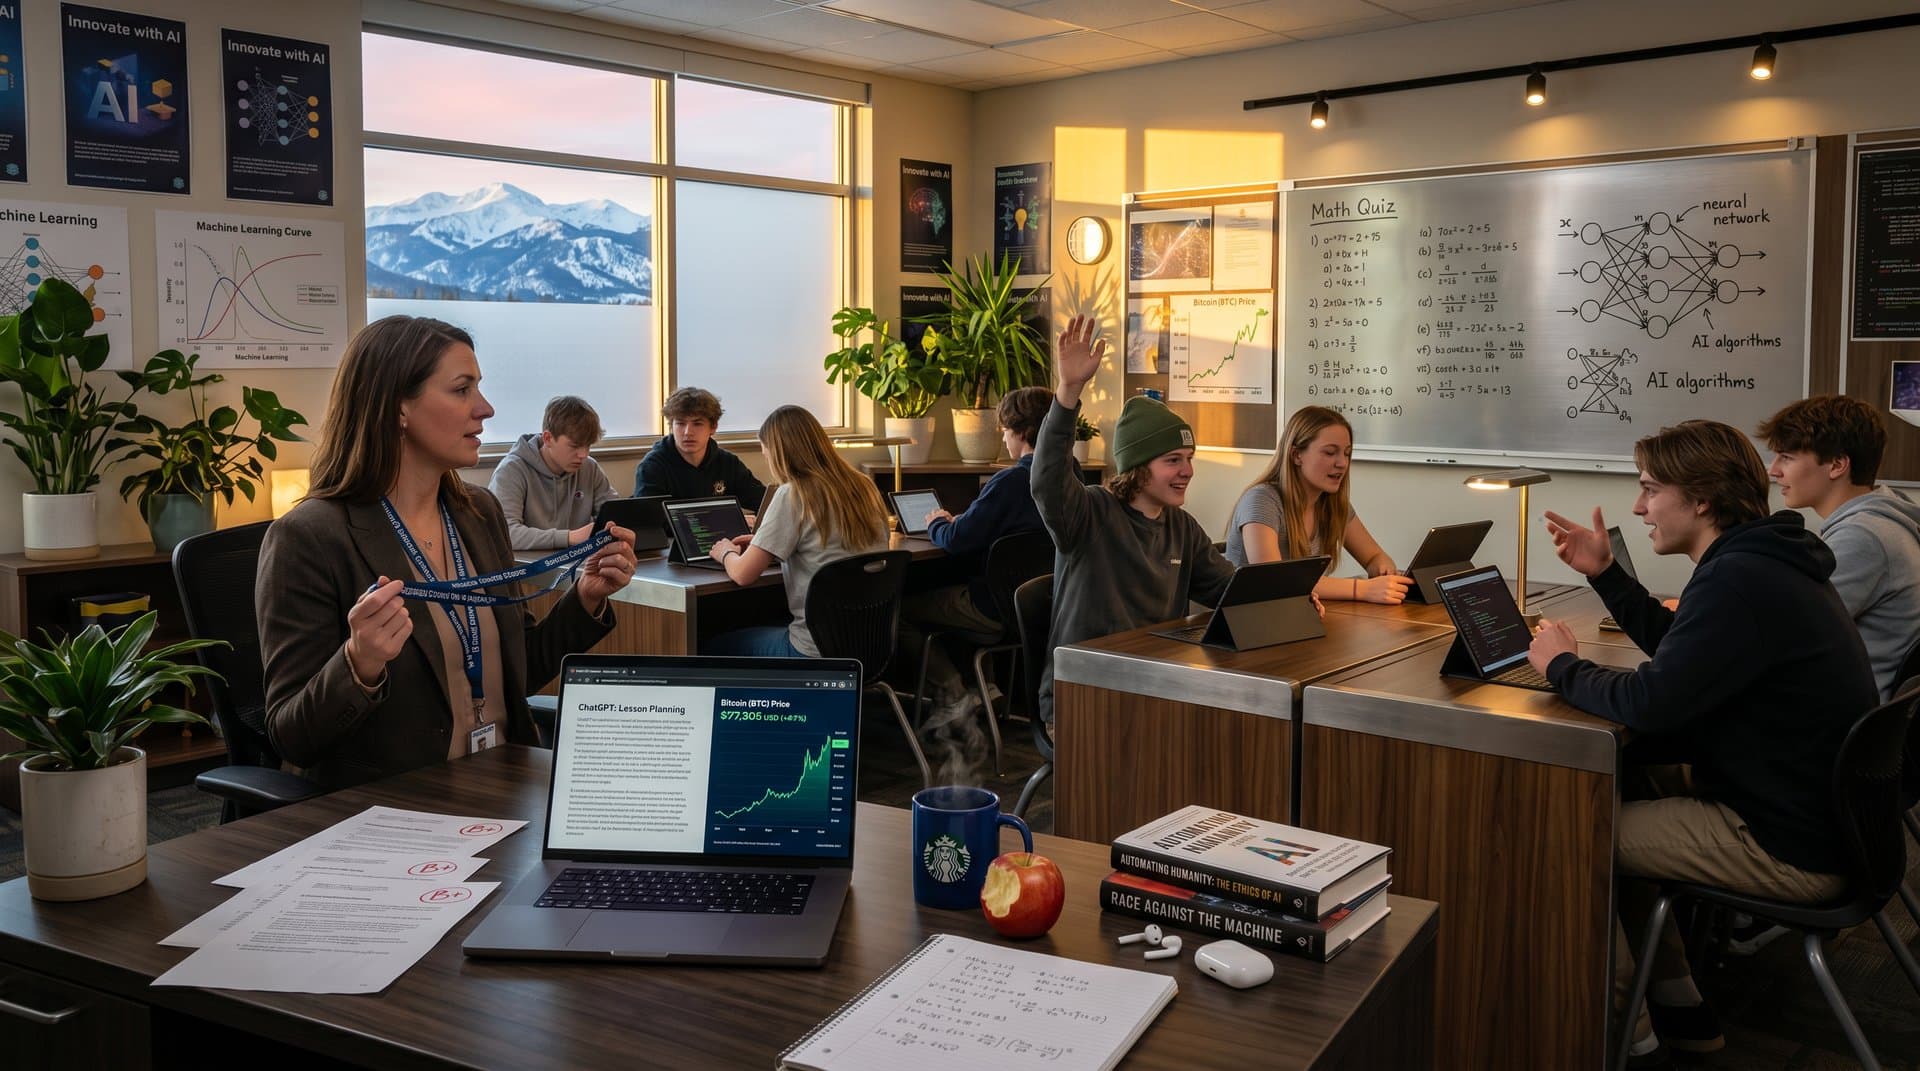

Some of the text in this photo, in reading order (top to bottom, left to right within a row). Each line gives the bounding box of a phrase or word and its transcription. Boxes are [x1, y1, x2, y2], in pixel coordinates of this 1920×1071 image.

[0, 5, 15, 19] AI
[68, 14, 182, 44] Innovate with AI
[228, 39, 326, 65] Innovate with AI
[87, 81, 139, 124] AI
[903, 165, 950, 179] Innovate with AI
[1703, 193, 1747, 210] neural
[1312, 198, 1397, 220] Math Quiz
[39, 212, 98, 229] Learning
[1713, 209, 1771, 226] network
[196, 221, 312, 237] Machine Learning Curve
[1417, 268, 1432, 279] (c)
[1324, 278, 1333, 288] c)
[1039, 294, 1048, 303] AI
[1193, 298, 1256, 307] Bitcoin (BTC) Price
[1309, 298, 1318, 309] 2)
[1376, 297, 1383, 306] 5
[1309, 317, 1318, 328] 3)
[1308, 338, 1318, 350] 4)
[1692, 333, 1782, 353] AI algorithms
[262, 354, 288, 362] Learning
[1308, 363, 1318, 376] 5)
[1647, 372, 1755, 394] AI algorithms
[1308, 384, 1318, 396] 6)
[578, 703, 686, 716] ChatGPT: Lesson Planning
[721, 699, 790, 709] Bitcoin (BTC) Price
[720, 711, 762, 721] $77,305
[1245, 837, 1320, 866] AI
[420, 863, 452, 873] B+
[1120, 853, 1282, 903] AUTOMATING HUMANITY: THE ETHICS OF AI
[430, 890, 463, 901] B+
[1111, 891, 1283, 944] RACE AGAINST THE MACHINE
